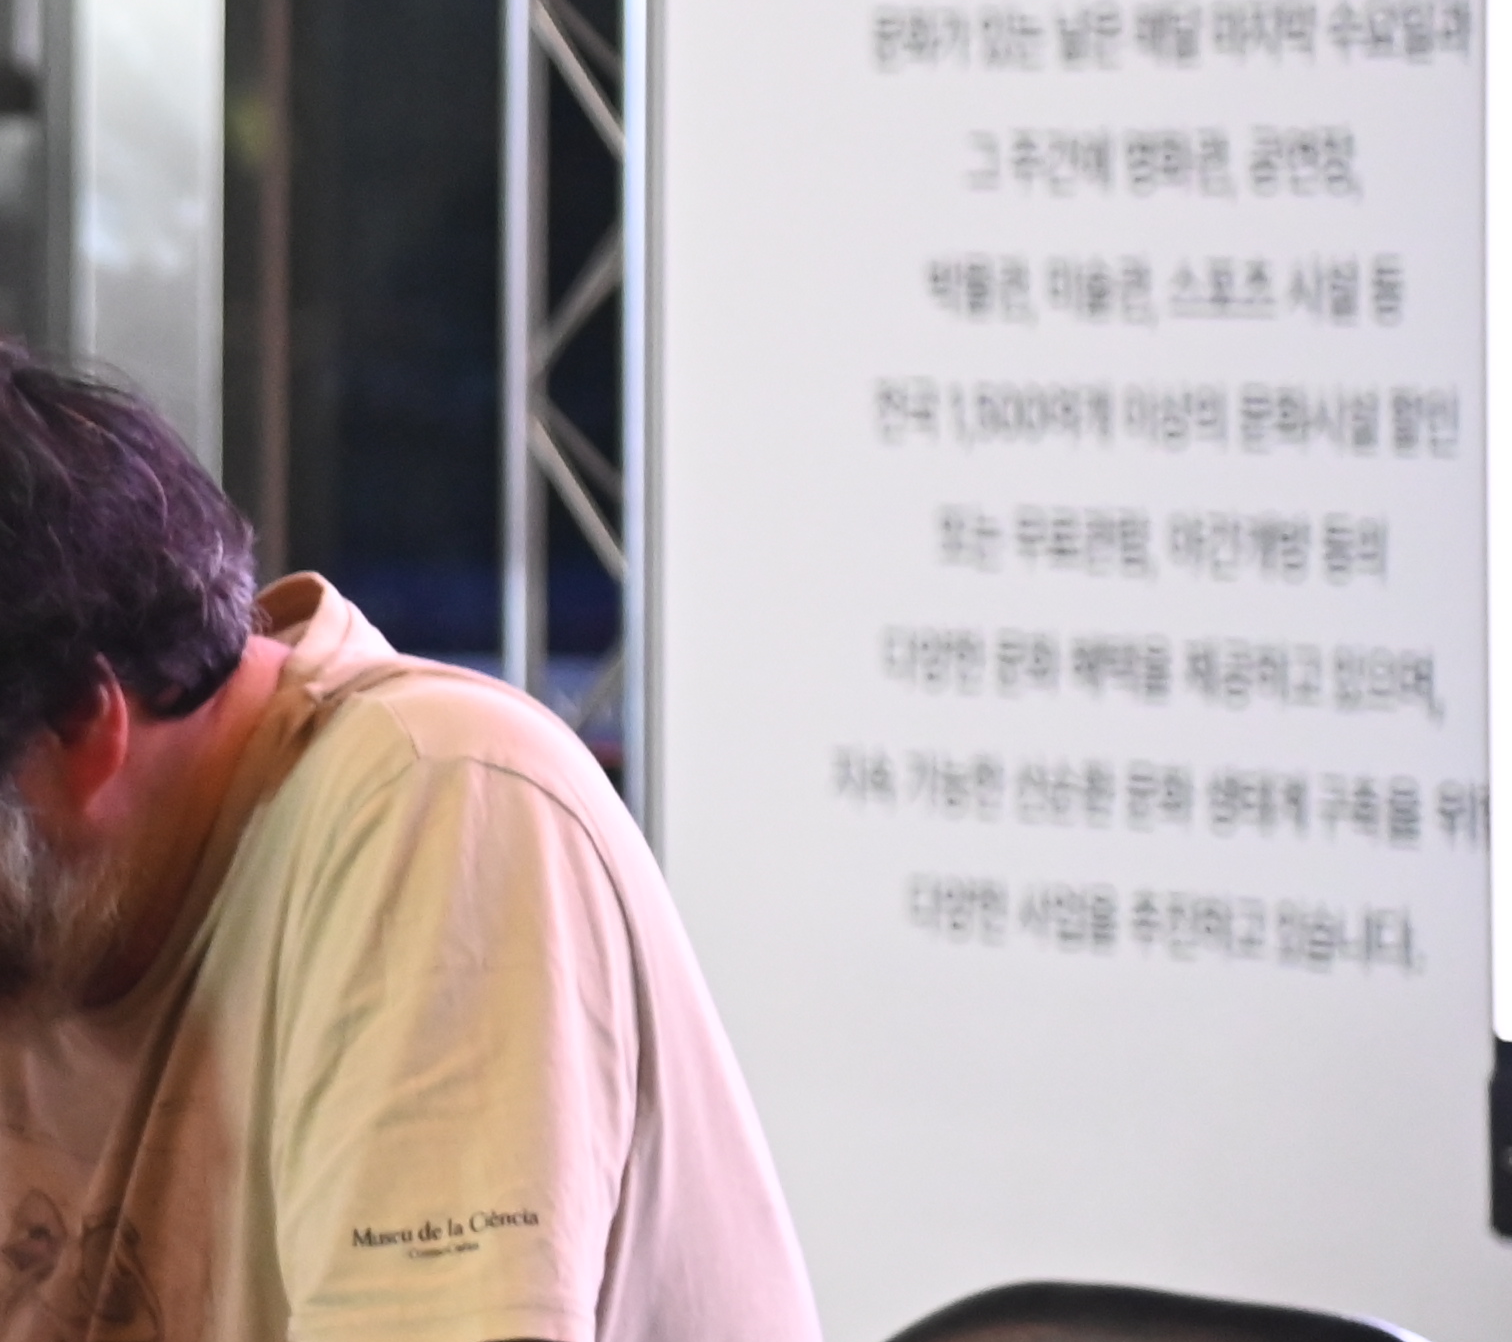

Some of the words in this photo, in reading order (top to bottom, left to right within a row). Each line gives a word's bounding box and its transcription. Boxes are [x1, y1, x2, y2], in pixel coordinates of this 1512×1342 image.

[870, 1, 970, 73] 문화가
[975, 1, 1046, 71] 있는
[966, 129, 1001, 190] 그
[1167, 256, 1278, 320] 스포츠
[1284, 255, 1362, 327] 시설
[1368, 253, 1406, 327] 등
[872, 376, 942, 446] 전국
[1120, 383, 1230, 453] 이상의
[1237, 381, 1381, 456] 문화시설
[1387, 385, 1461, 459] 할인
[1320, 512, 1390, 586] 등의
[882, 625, 987, 696] 다양한
[992, 627, 1061, 698] 문화
[1067, 633, 1174, 706] 혜택을
[1181, 637, 1324, 711] 제공하고
[831, 745, 897, 806] 지속
[905, 750, 1006, 822] 가능한
[1123, 759, 1196, 833] 문화
[1318, 771, 1425, 850] 구축을
[1433, 778, 1489, 852] 위
[908, 872, 1010, 947] 다양한
[1016, 881, 1121, 956] 사업을
[352, 1226, 413, 1247] Museu
[418, 1220, 442, 1242] de
[448, 1218, 463, 1236] la
